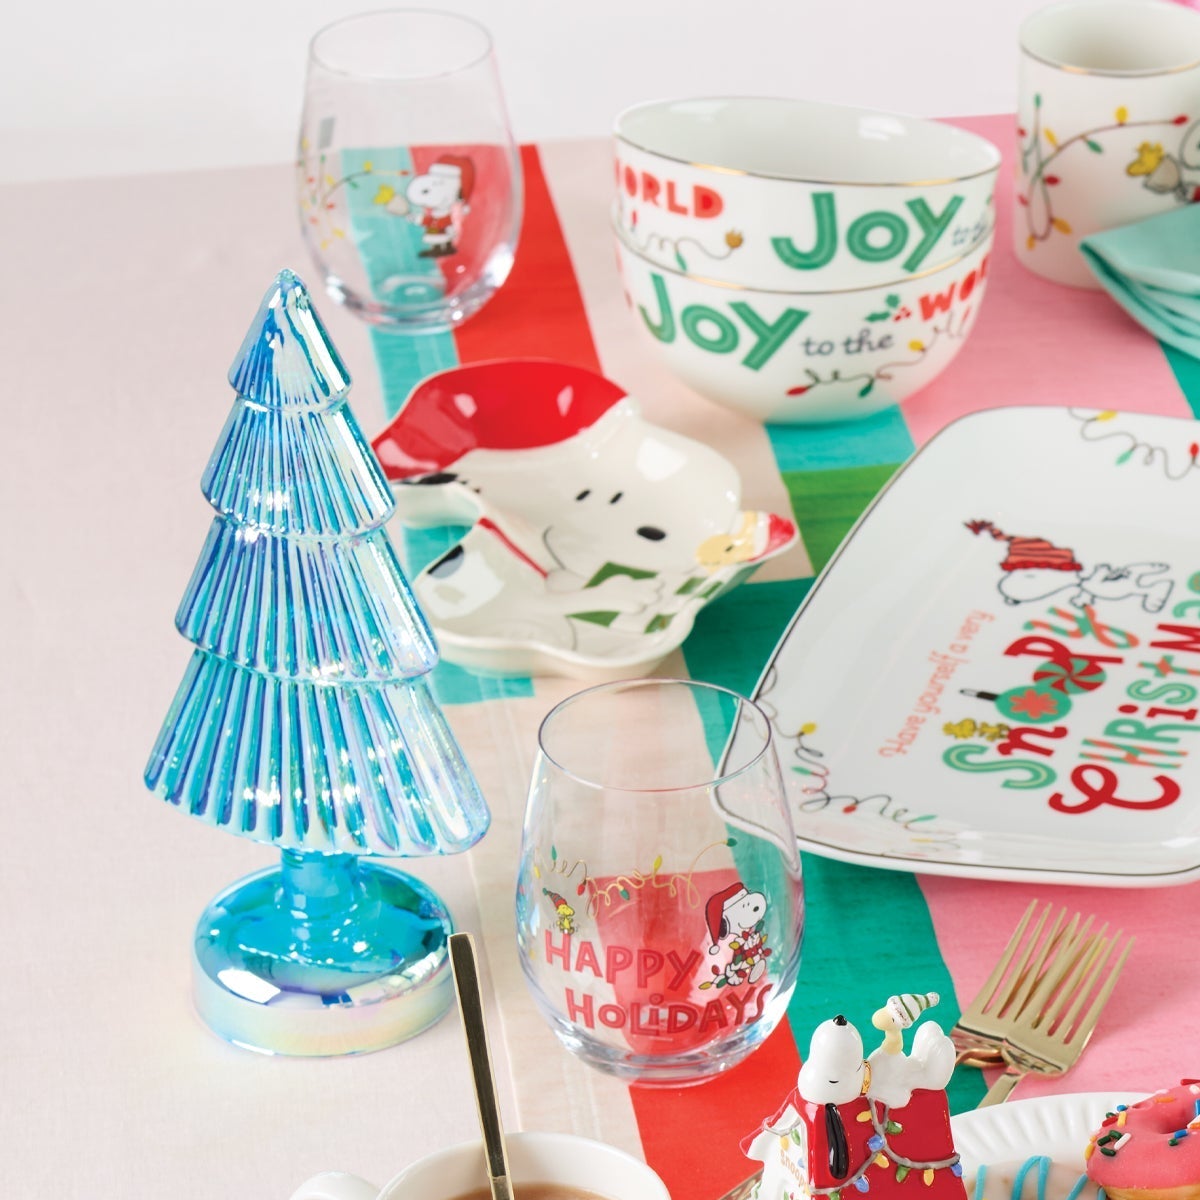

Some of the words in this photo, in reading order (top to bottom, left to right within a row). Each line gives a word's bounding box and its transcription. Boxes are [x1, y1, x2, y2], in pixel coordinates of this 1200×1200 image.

[614, 157, 724, 220] ORLD
[771, 192, 966, 273] JOY
[637, 272, 811, 372] JOY
[801, 337, 835, 356] to
[842, 327, 894, 355] the
[878, 714, 926, 758] Have
[911, 648, 972, 716] yourself
[545, 929, 704, 991] HAPPY
